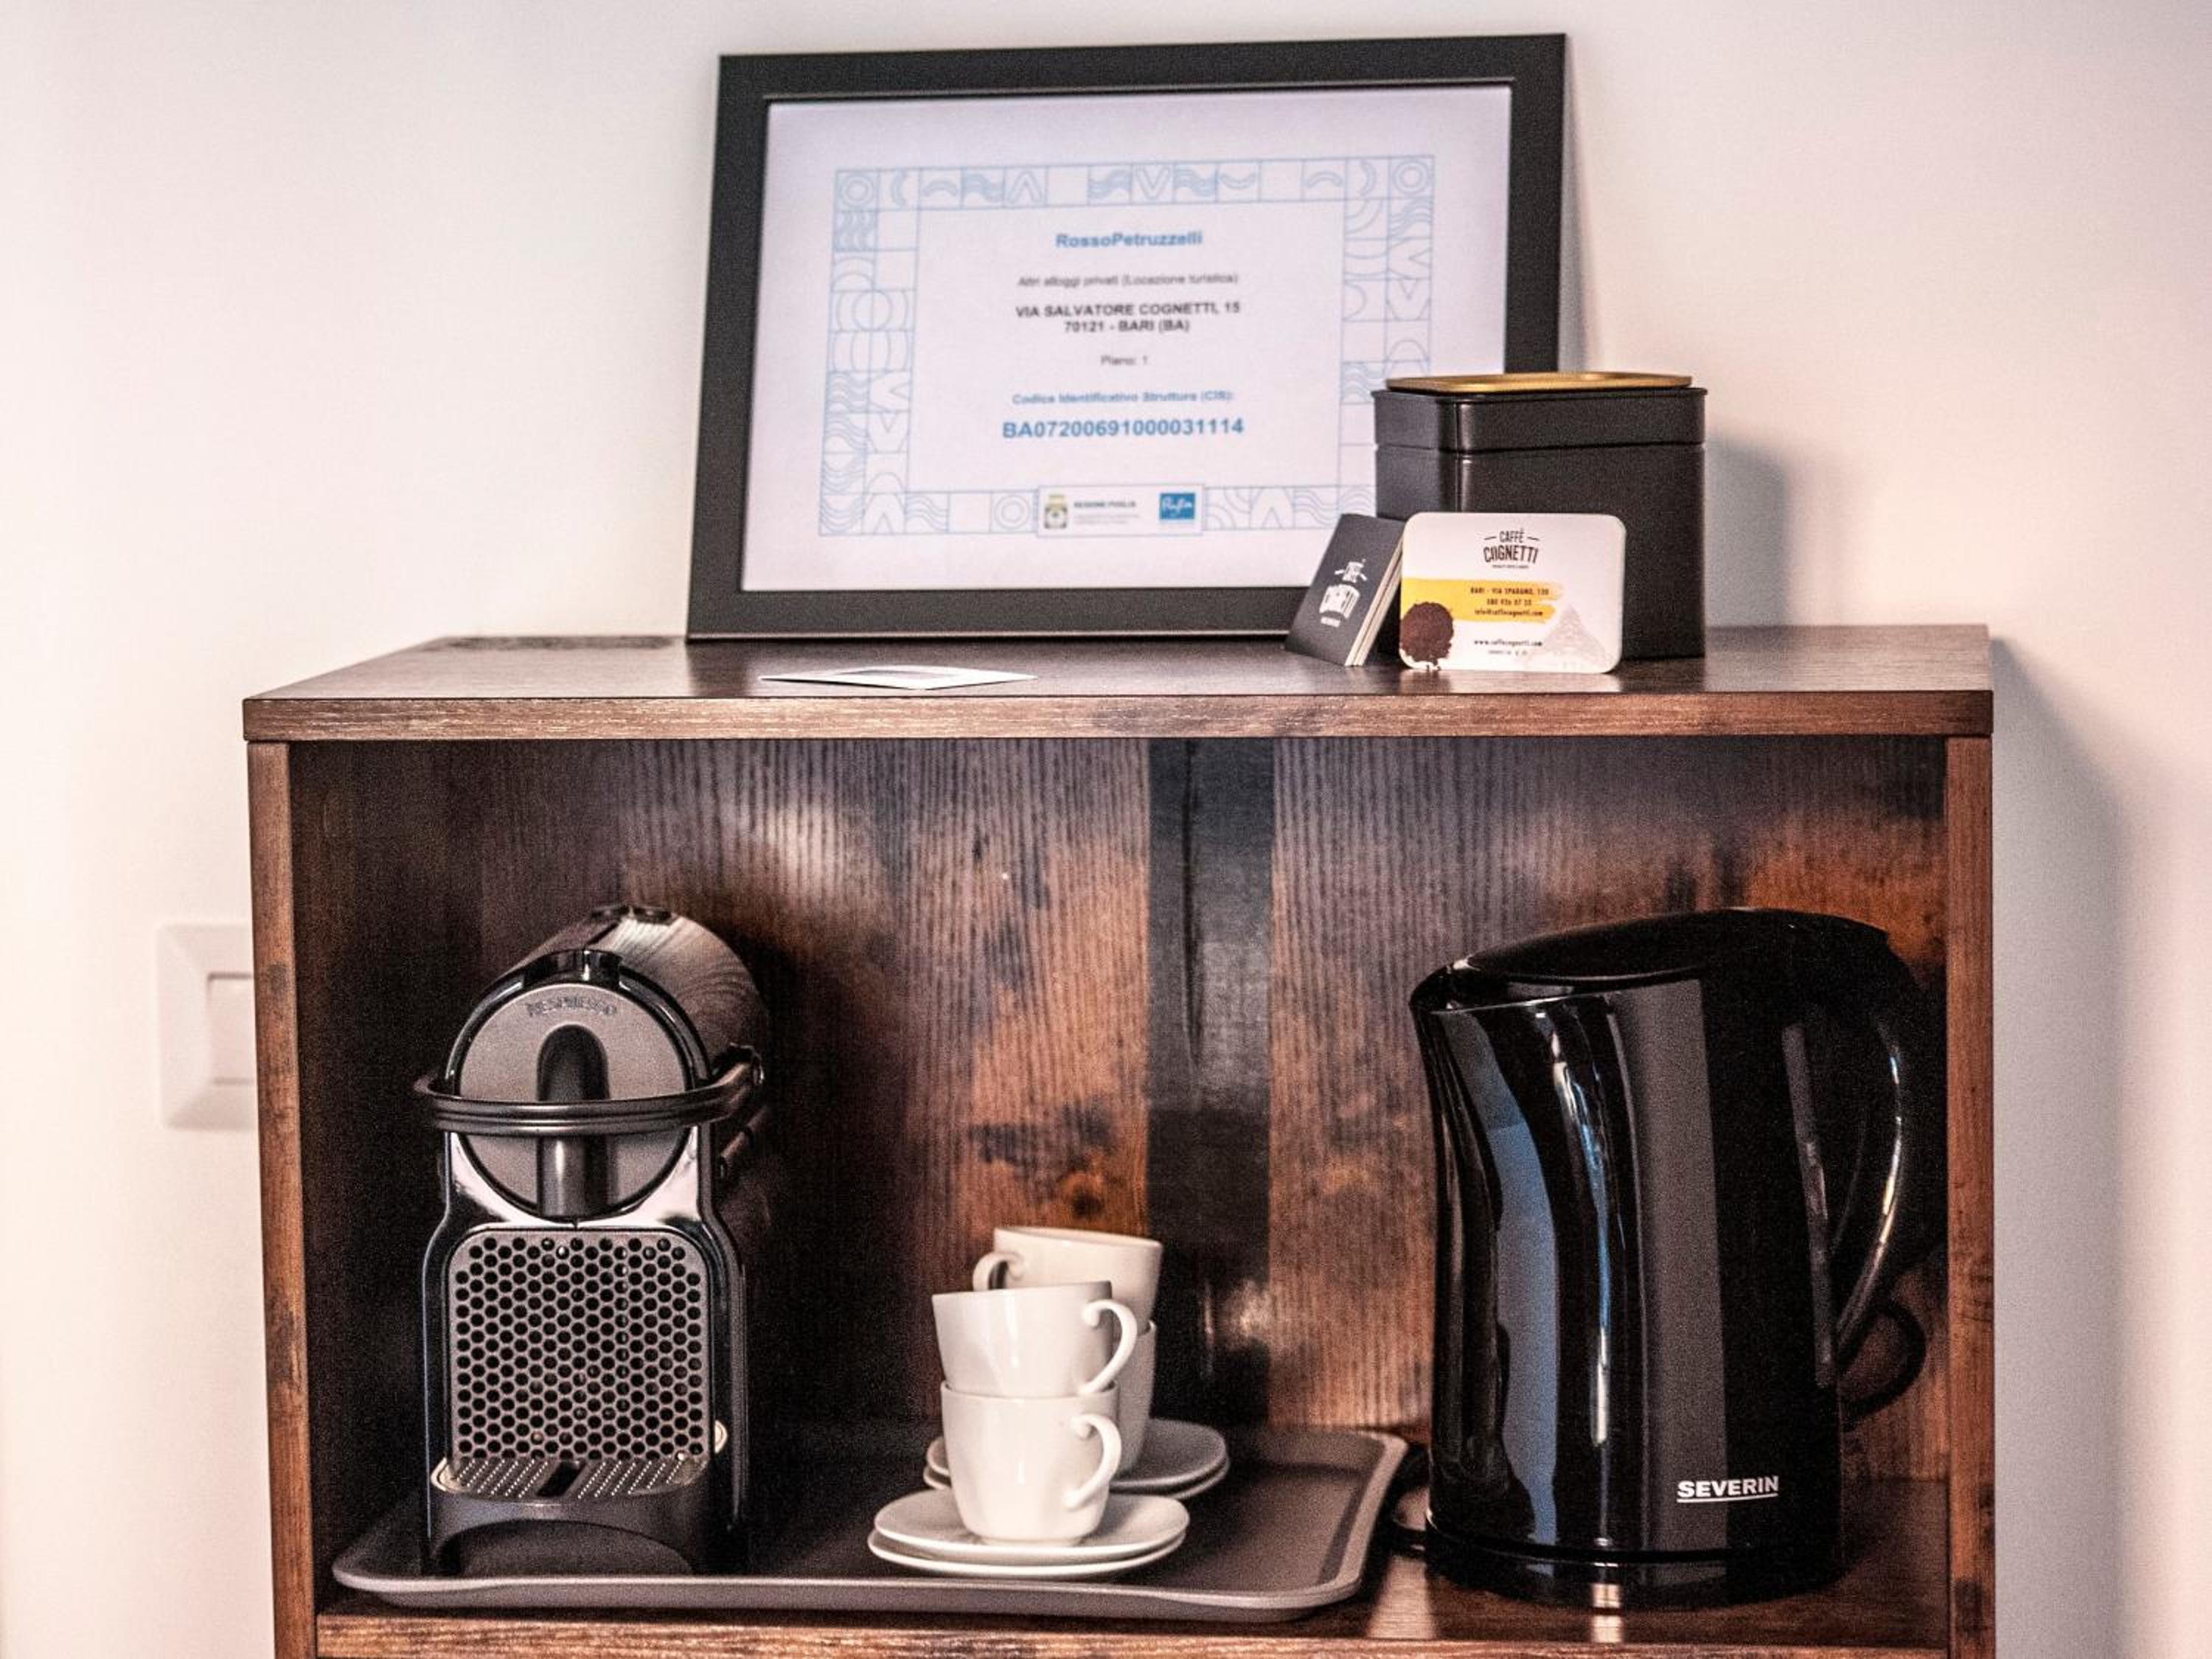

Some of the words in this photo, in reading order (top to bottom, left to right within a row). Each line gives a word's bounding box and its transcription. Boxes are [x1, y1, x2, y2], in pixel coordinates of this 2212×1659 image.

[1055, 231, 1203, 248] RossoPetruzzelli
[1043, 276, 1080, 288] alloggi
[1084, 275, 1118, 288] privati
[1121, 274, 1185, 286] (Locazione
[1015, 305, 1040, 317] VIA
[1044, 304, 1134, 316] SALVATORE
[1139, 302, 1219, 316] COGNETTI,
[1224, 302, 1240, 313] 15
[1064, 321, 1105, 333] 70121
[1119, 319, 1154, 332] BARI
[1158, 319, 1190, 333] (BA)
[1012, 392, 1055, 405] Codice
[1059, 391, 1138, 404] Identificativo
[1001, 417, 1245, 439] BA07200691000031114
[1483, 544, 1539, 564] COGNETTI
[1676, 1475, 1779, 1498] SEVERIN
